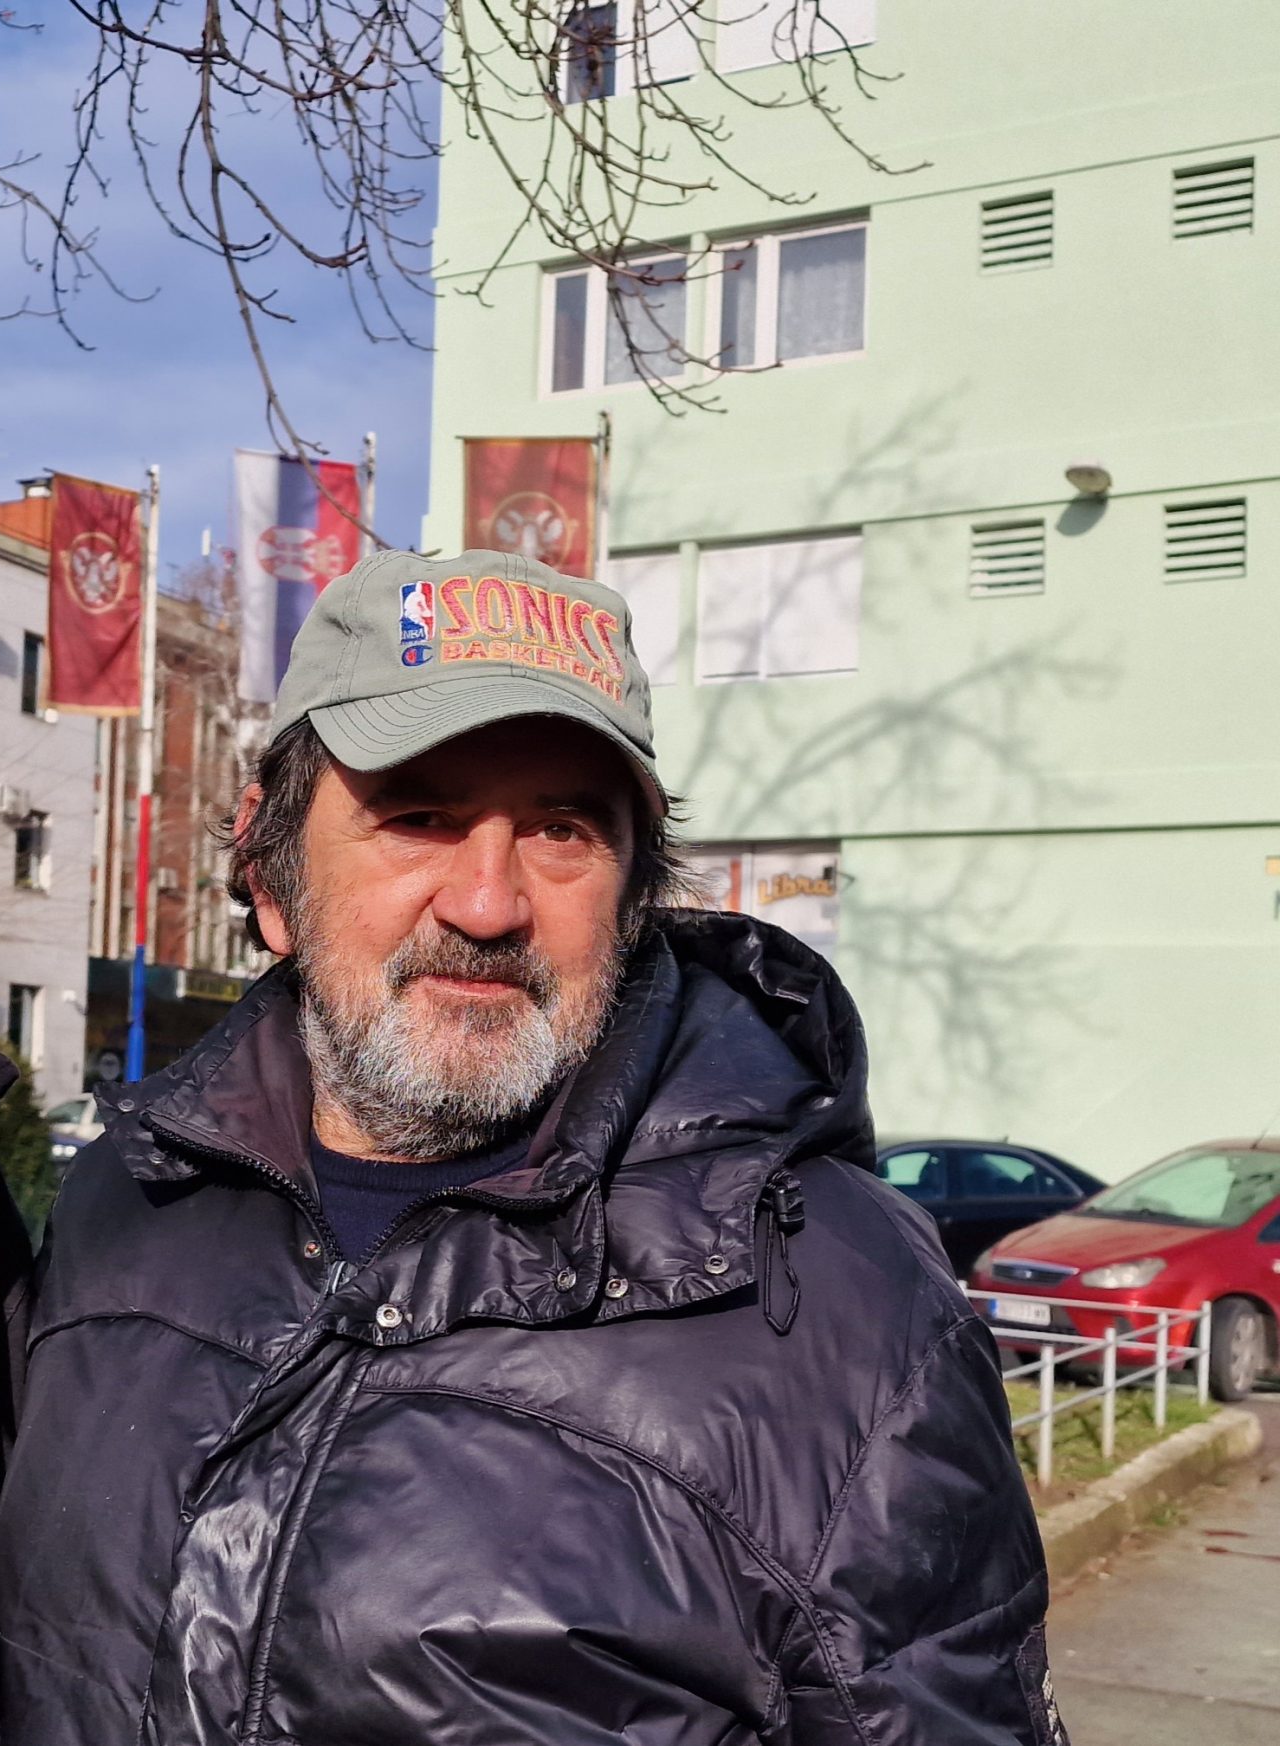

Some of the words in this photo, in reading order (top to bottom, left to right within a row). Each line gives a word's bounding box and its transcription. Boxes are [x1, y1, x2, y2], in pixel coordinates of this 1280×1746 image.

[401, 628, 424, 640] NBA
[439, 576, 623, 680] SONICS
[759, 873, 833, 904] Libra
